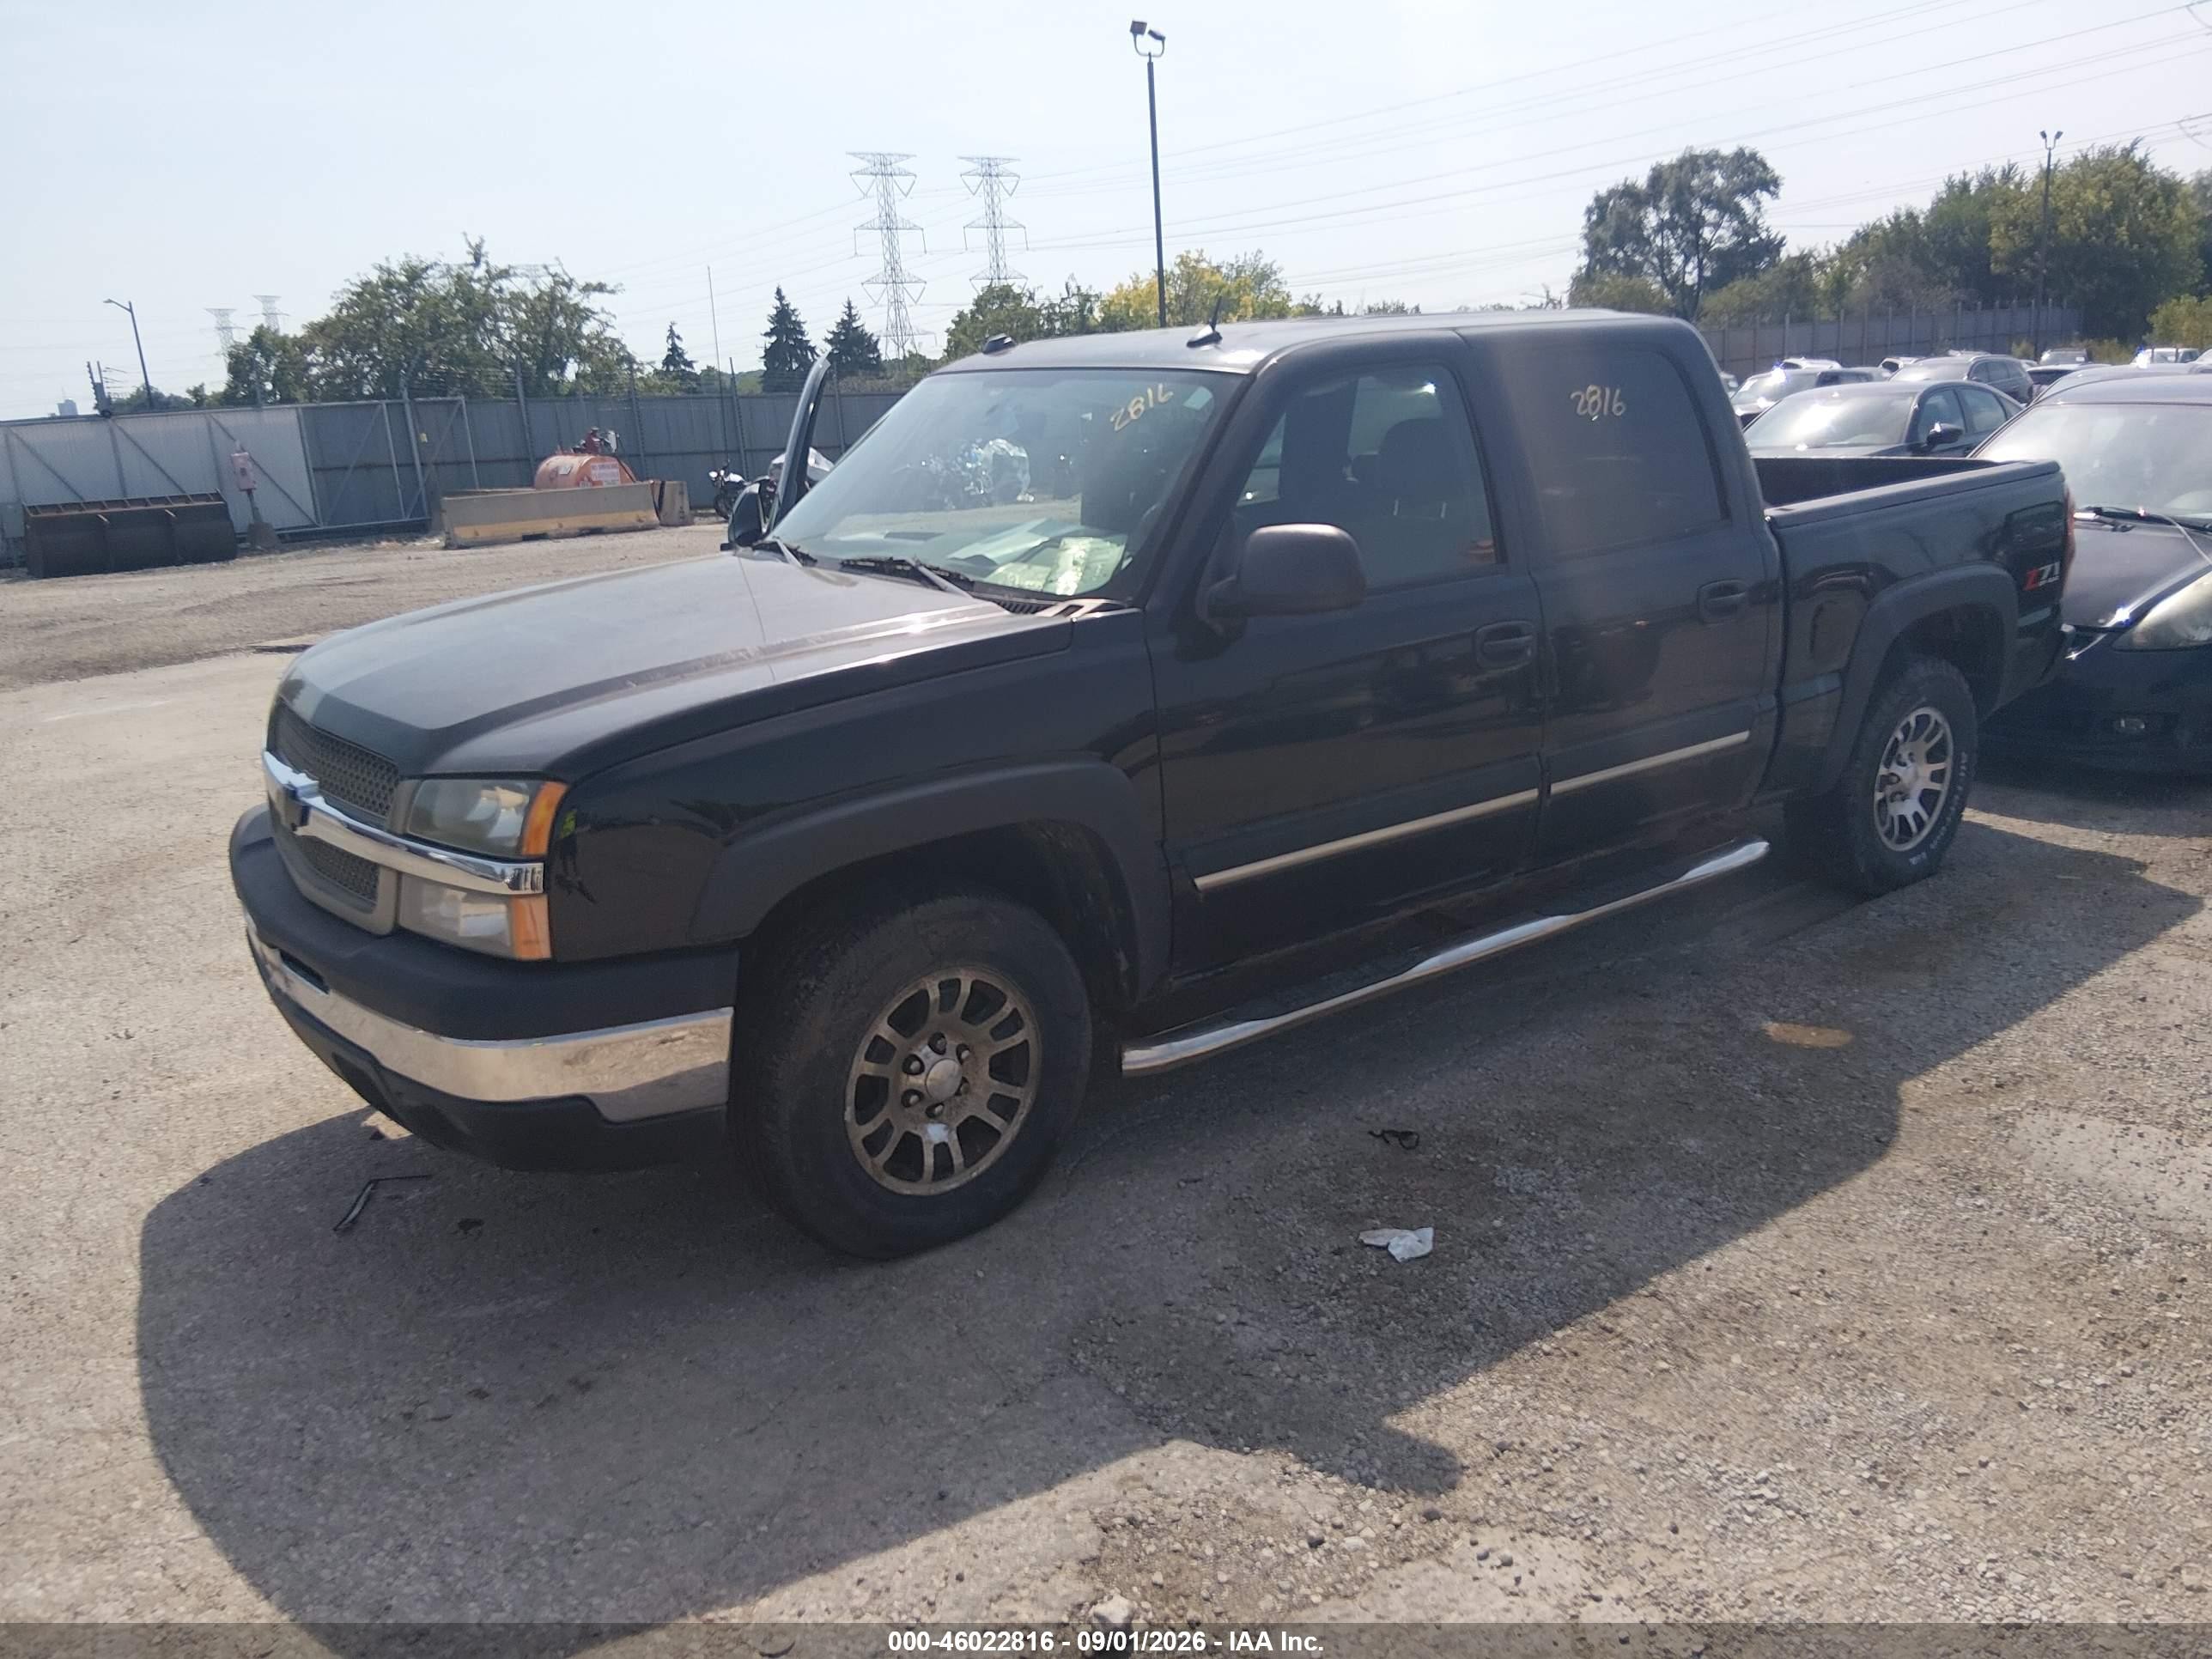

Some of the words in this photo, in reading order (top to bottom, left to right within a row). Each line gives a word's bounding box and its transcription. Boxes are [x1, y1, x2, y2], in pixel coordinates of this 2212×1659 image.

[1109, 383, 1174, 432] 2816
[1570, 384, 1626, 417] 2816
[2022, 561, 2061, 591] Z71
